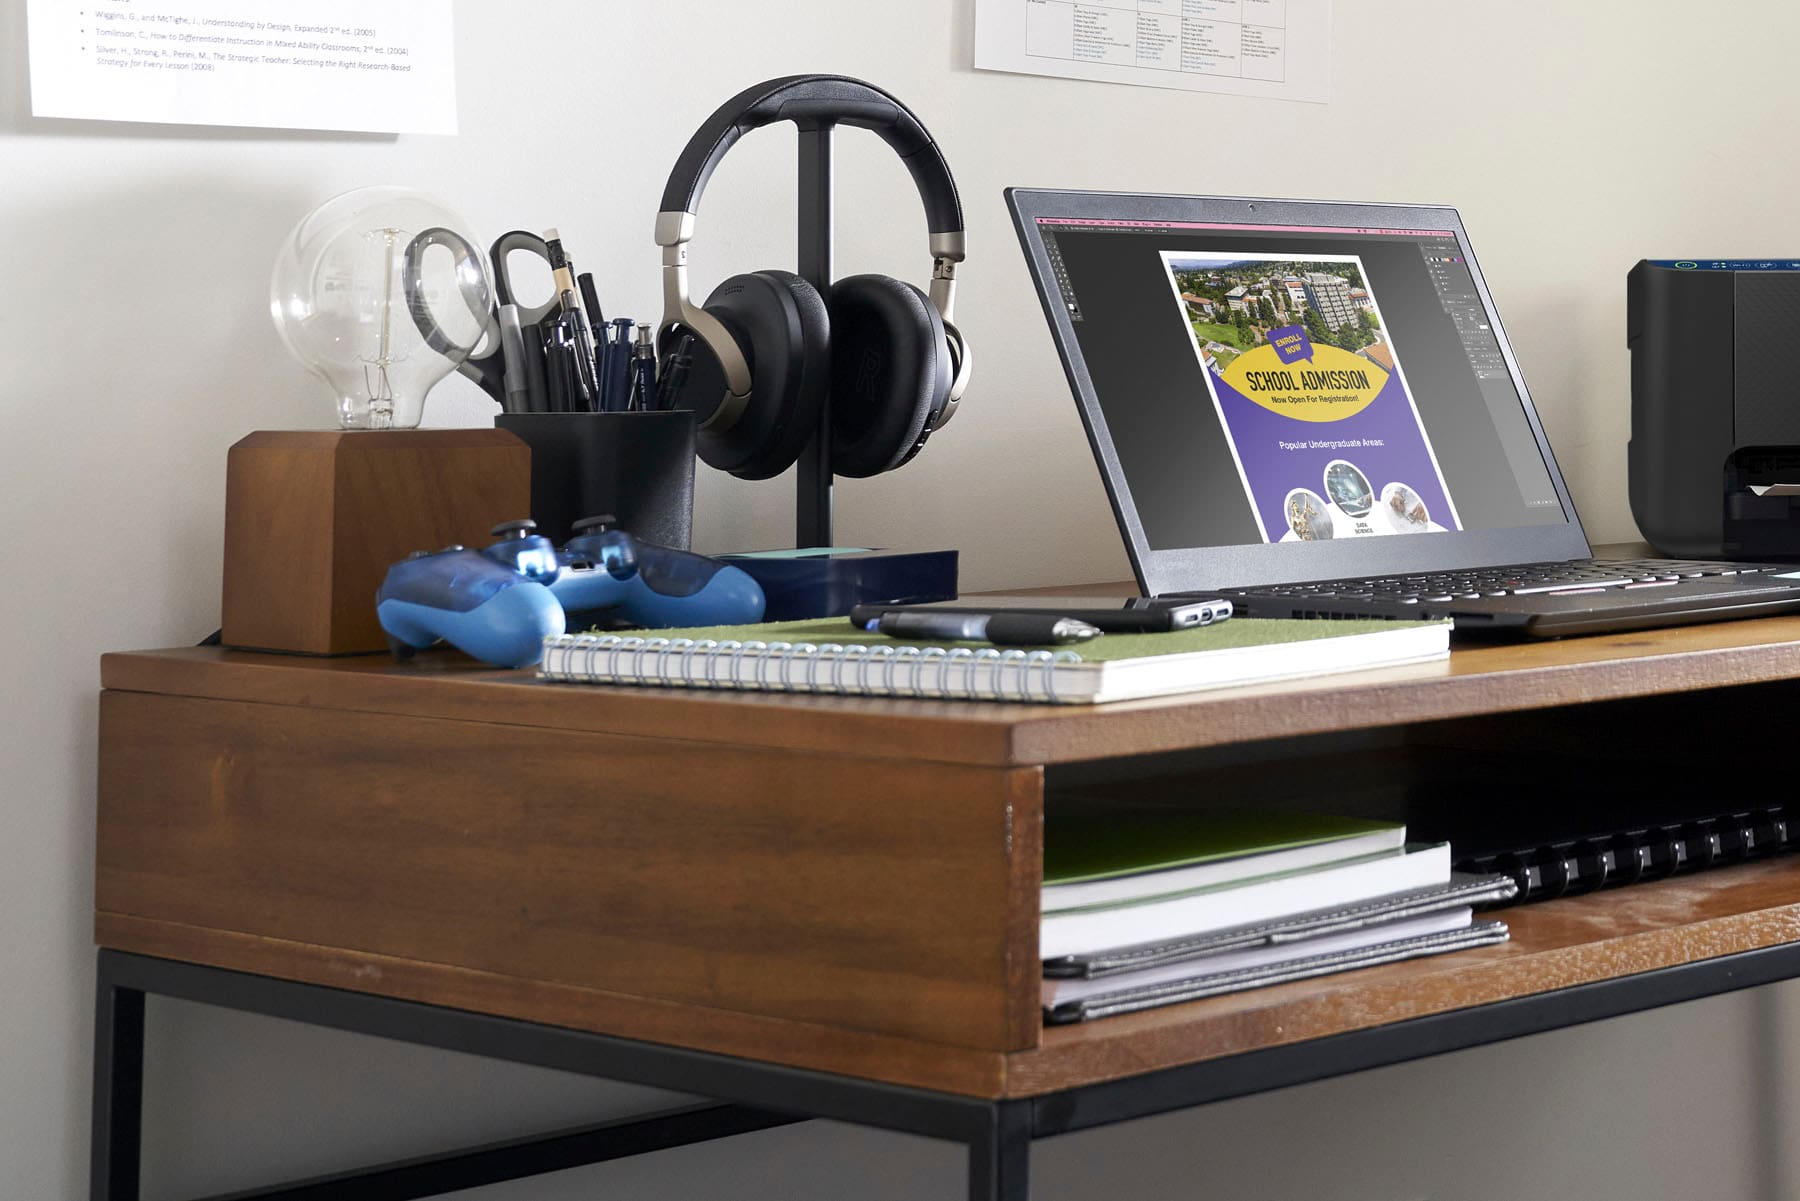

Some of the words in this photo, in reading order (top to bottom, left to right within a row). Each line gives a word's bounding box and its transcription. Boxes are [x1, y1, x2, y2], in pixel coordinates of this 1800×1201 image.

[1275, 333, 1303, 348] ENROLL
[1284, 343, 1302, 356] NOW
[1245, 370, 1300, 392] SCHOOL
[1300, 369, 1371, 391] ADMISSION
[1271, 396, 1287, 404] Now
[1287, 395, 1306, 405] Open
[1307, 395, 1318, 403] For
[1279, 440, 1307, 451] Popular
[1308, 439, 1361, 450] Undergraduate
[1362, 438, 1385, 447] Areas:
